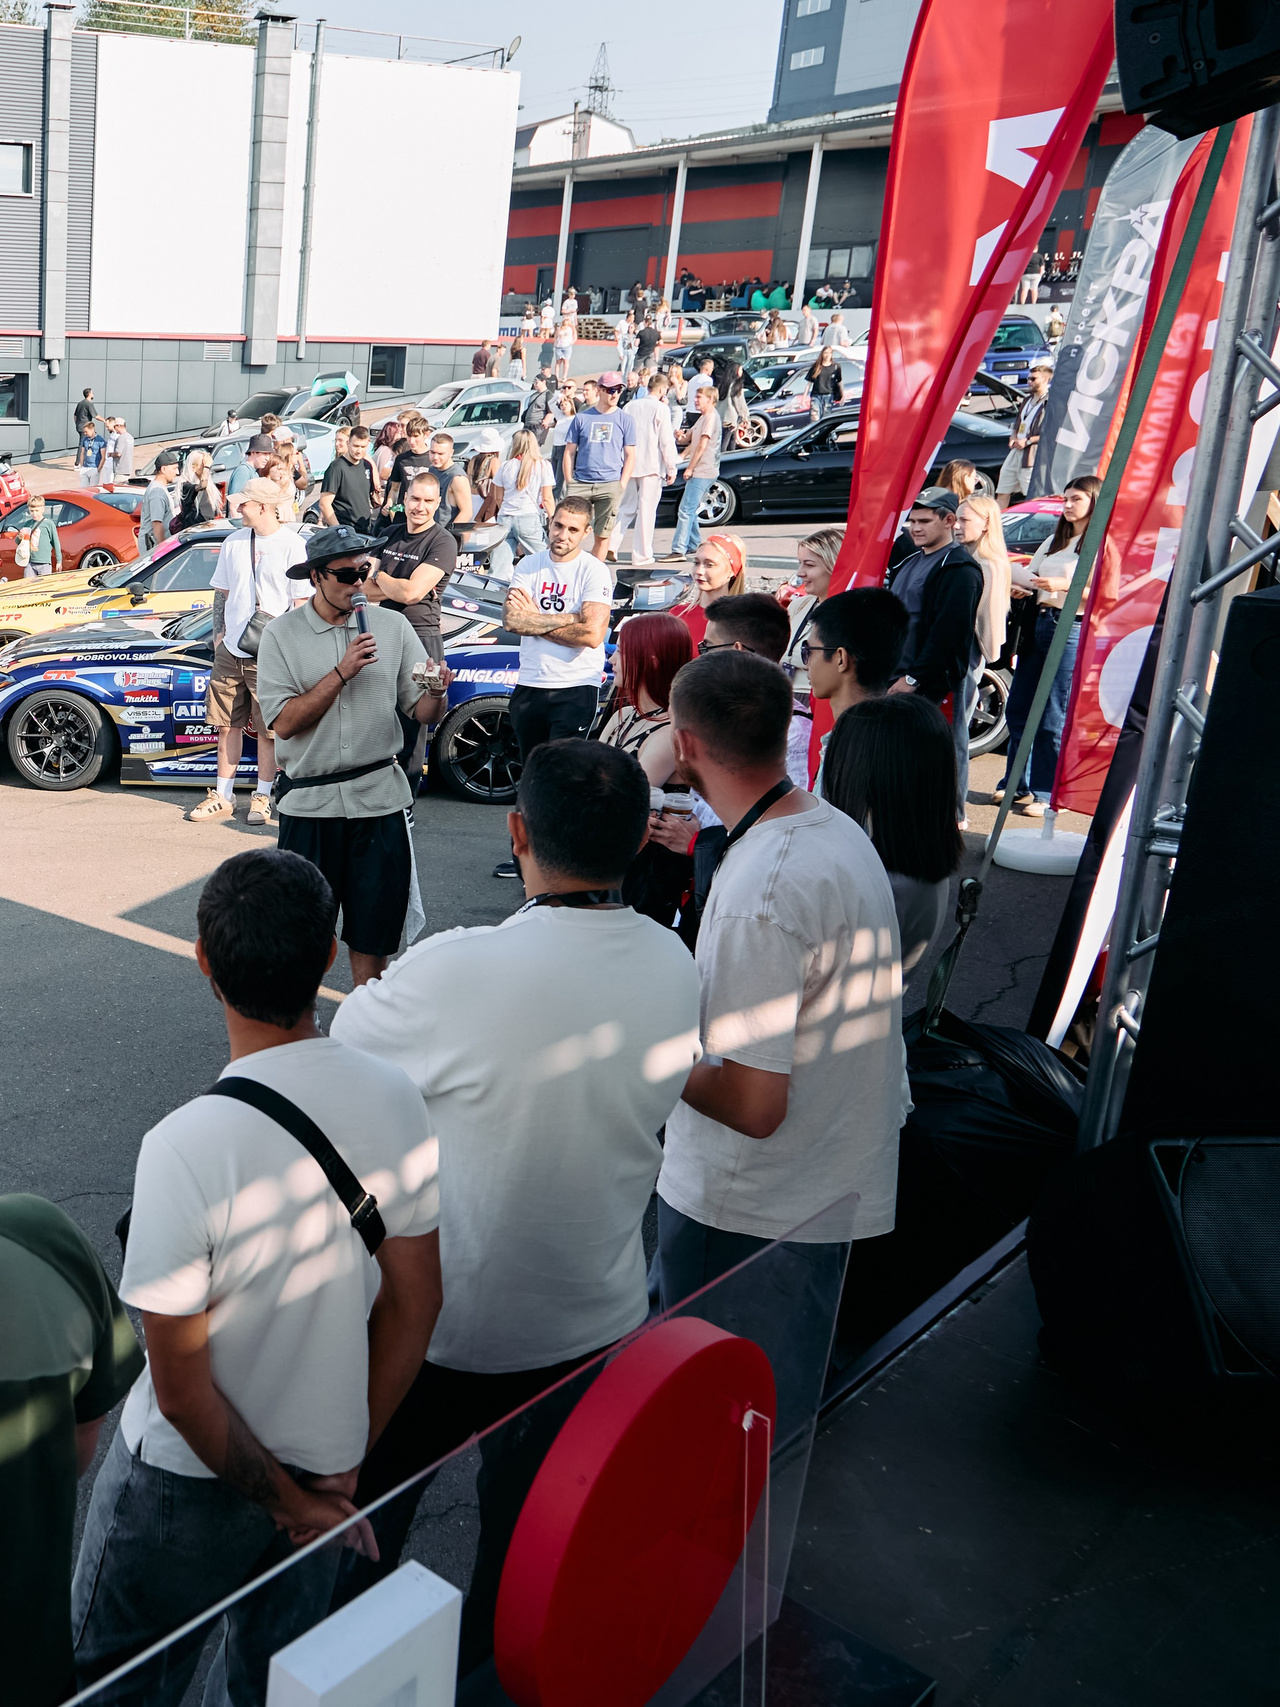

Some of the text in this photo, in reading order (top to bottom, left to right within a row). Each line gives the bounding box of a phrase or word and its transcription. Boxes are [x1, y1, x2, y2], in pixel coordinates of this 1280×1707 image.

[541, 581, 568, 597] HU
[76, 653, 156, 662] DOBROVOLSKIY
[42, 670, 77, 680] CTR
[452, 669, 519, 685] LINGLON
[176, 705, 207, 717] AIM
[169, 763, 218, 772] ФОРВАР
